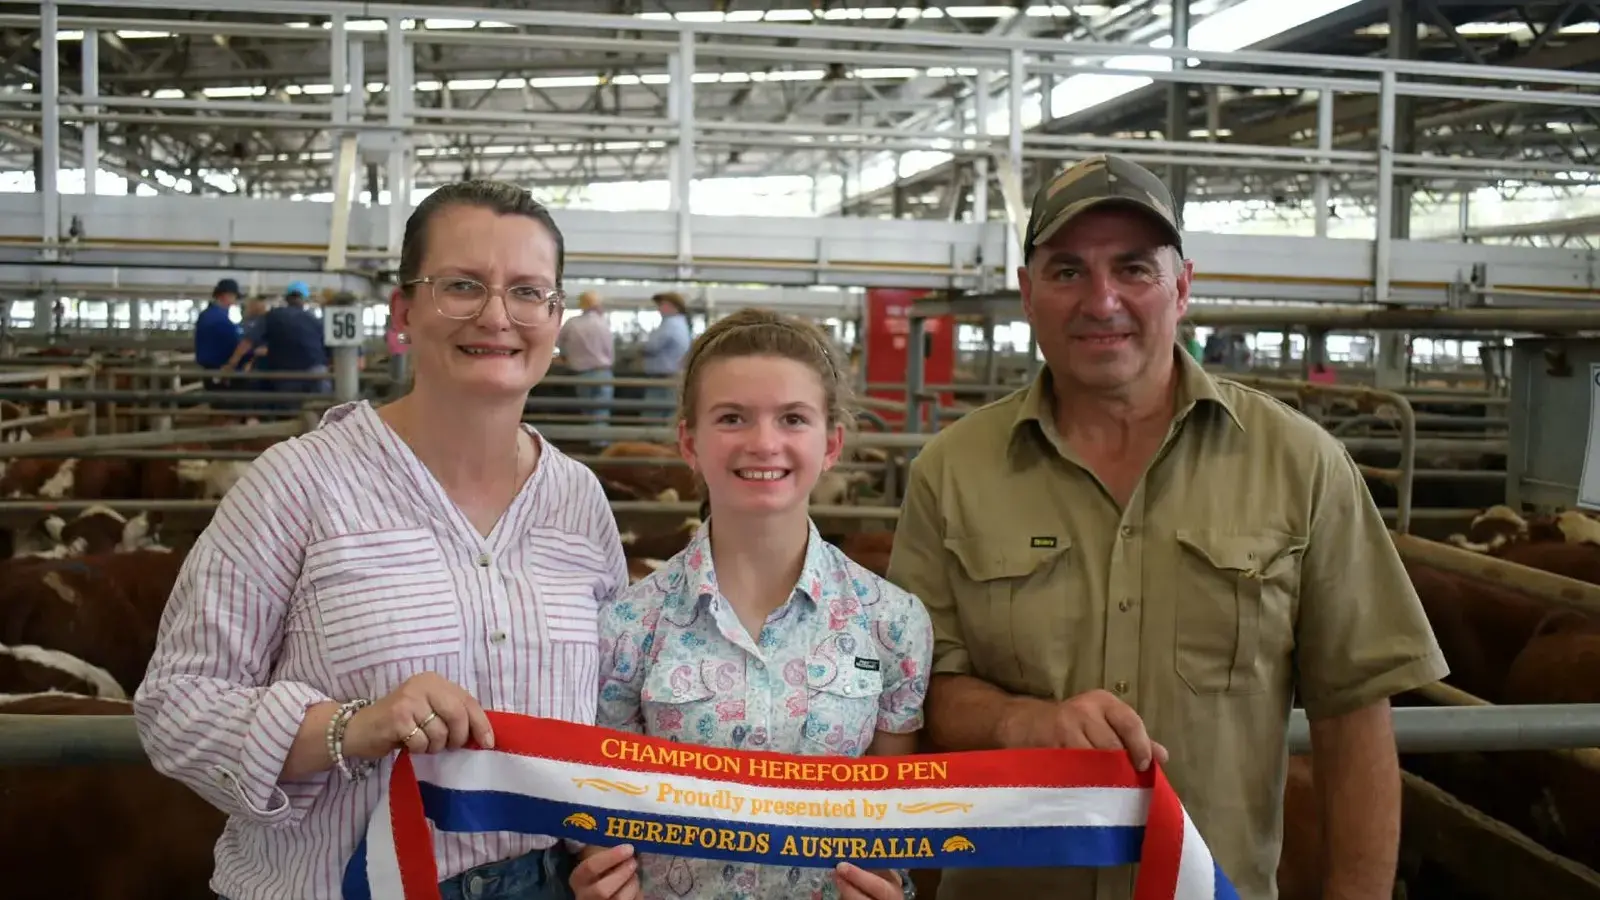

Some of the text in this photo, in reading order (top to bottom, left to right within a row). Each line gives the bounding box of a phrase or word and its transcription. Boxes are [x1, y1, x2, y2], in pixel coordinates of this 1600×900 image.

[333, 313, 356, 339] 56
[601, 738, 948, 782] CHAMPION HEREFORD PEN
[656, 783, 887, 820] Proudly presented by
[605, 817, 935, 858] HEREFORDS AUSTRALIA
